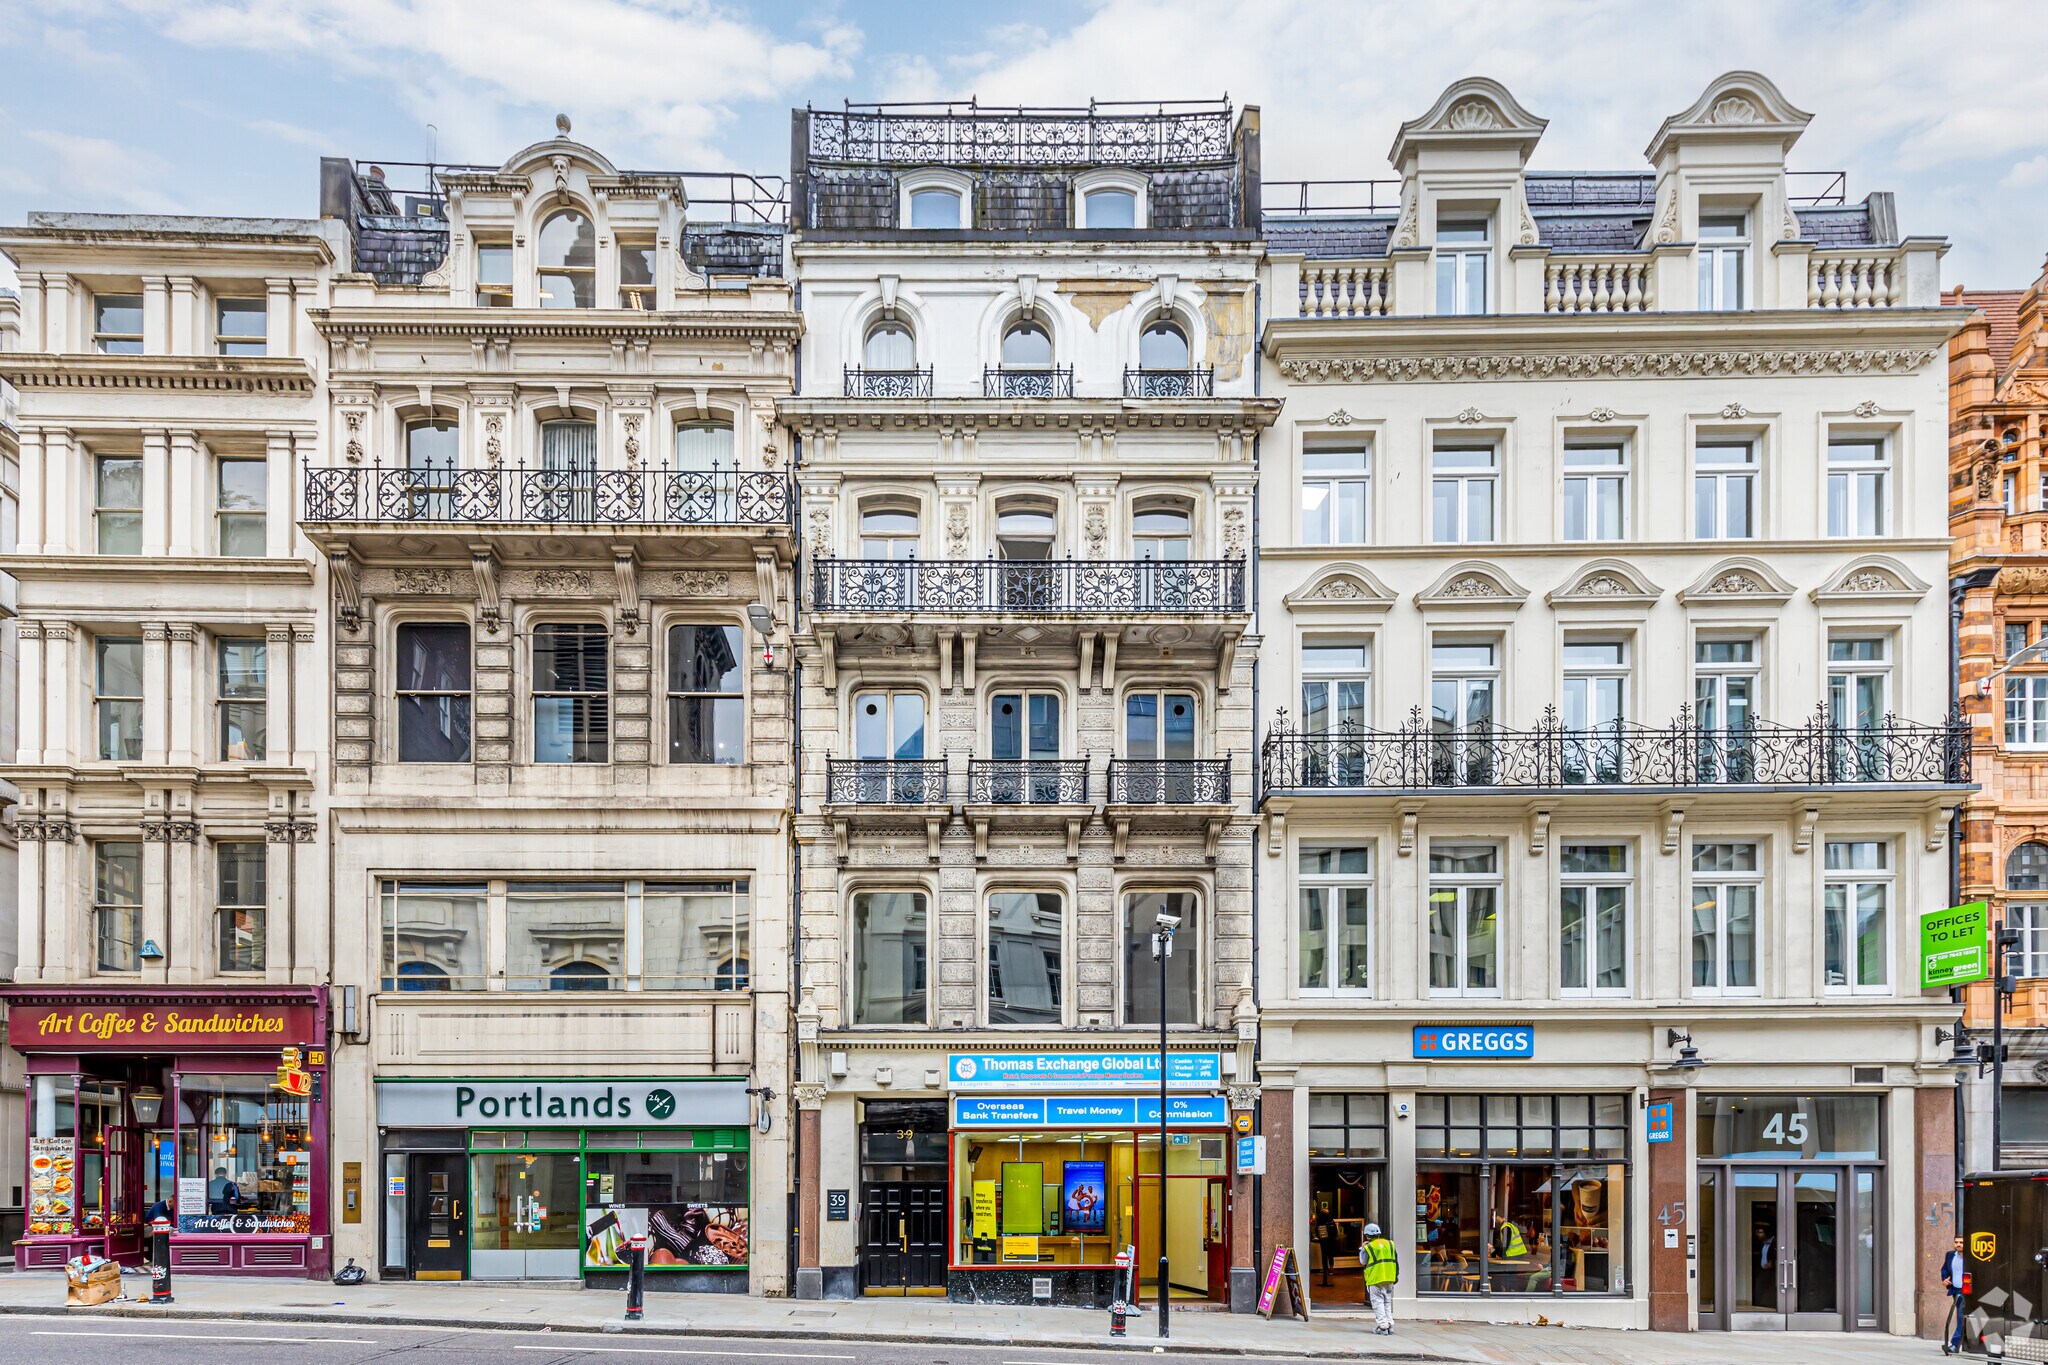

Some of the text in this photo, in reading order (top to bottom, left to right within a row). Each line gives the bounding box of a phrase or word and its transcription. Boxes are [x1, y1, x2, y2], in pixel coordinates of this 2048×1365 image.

[1926, 911, 1980, 931] OFFICES
[1931, 926, 1975, 942] TO LET
[38, 1012, 284, 1039] Art Coffee & Sandwiches
[1442, 1033, 1528, 1050] GREGGS
[982, 1057, 1161, 1073] Thomas Exchange Global Lt
[456, 1086, 631, 1118] Portlands
[977, 1102, 1025, 1110] Overseas
[1173, 1101, 1188, 1109] 0%
[962, 1110, 1039, 1120] Bank Transfers
[1057, 1106, 1123, 1116] Travel Money
[896, 1129, 914, 1140] 39
[1648, 1131, 1669, 1140] GREGGS
[1762, 1112, 1809, 1145] 45
[830, 1195, 846, 1206] 39
[1656, 1201, 1687, 1226] 45
[1924, 1202, 1954, 1227] 45
[194, 1218, 208, 1228] Art
[235, 1218, 244, 1228] &
[245, 1218, 295, 1228] Sandwiches
[1973, 1240, 1994, 1256] ups
